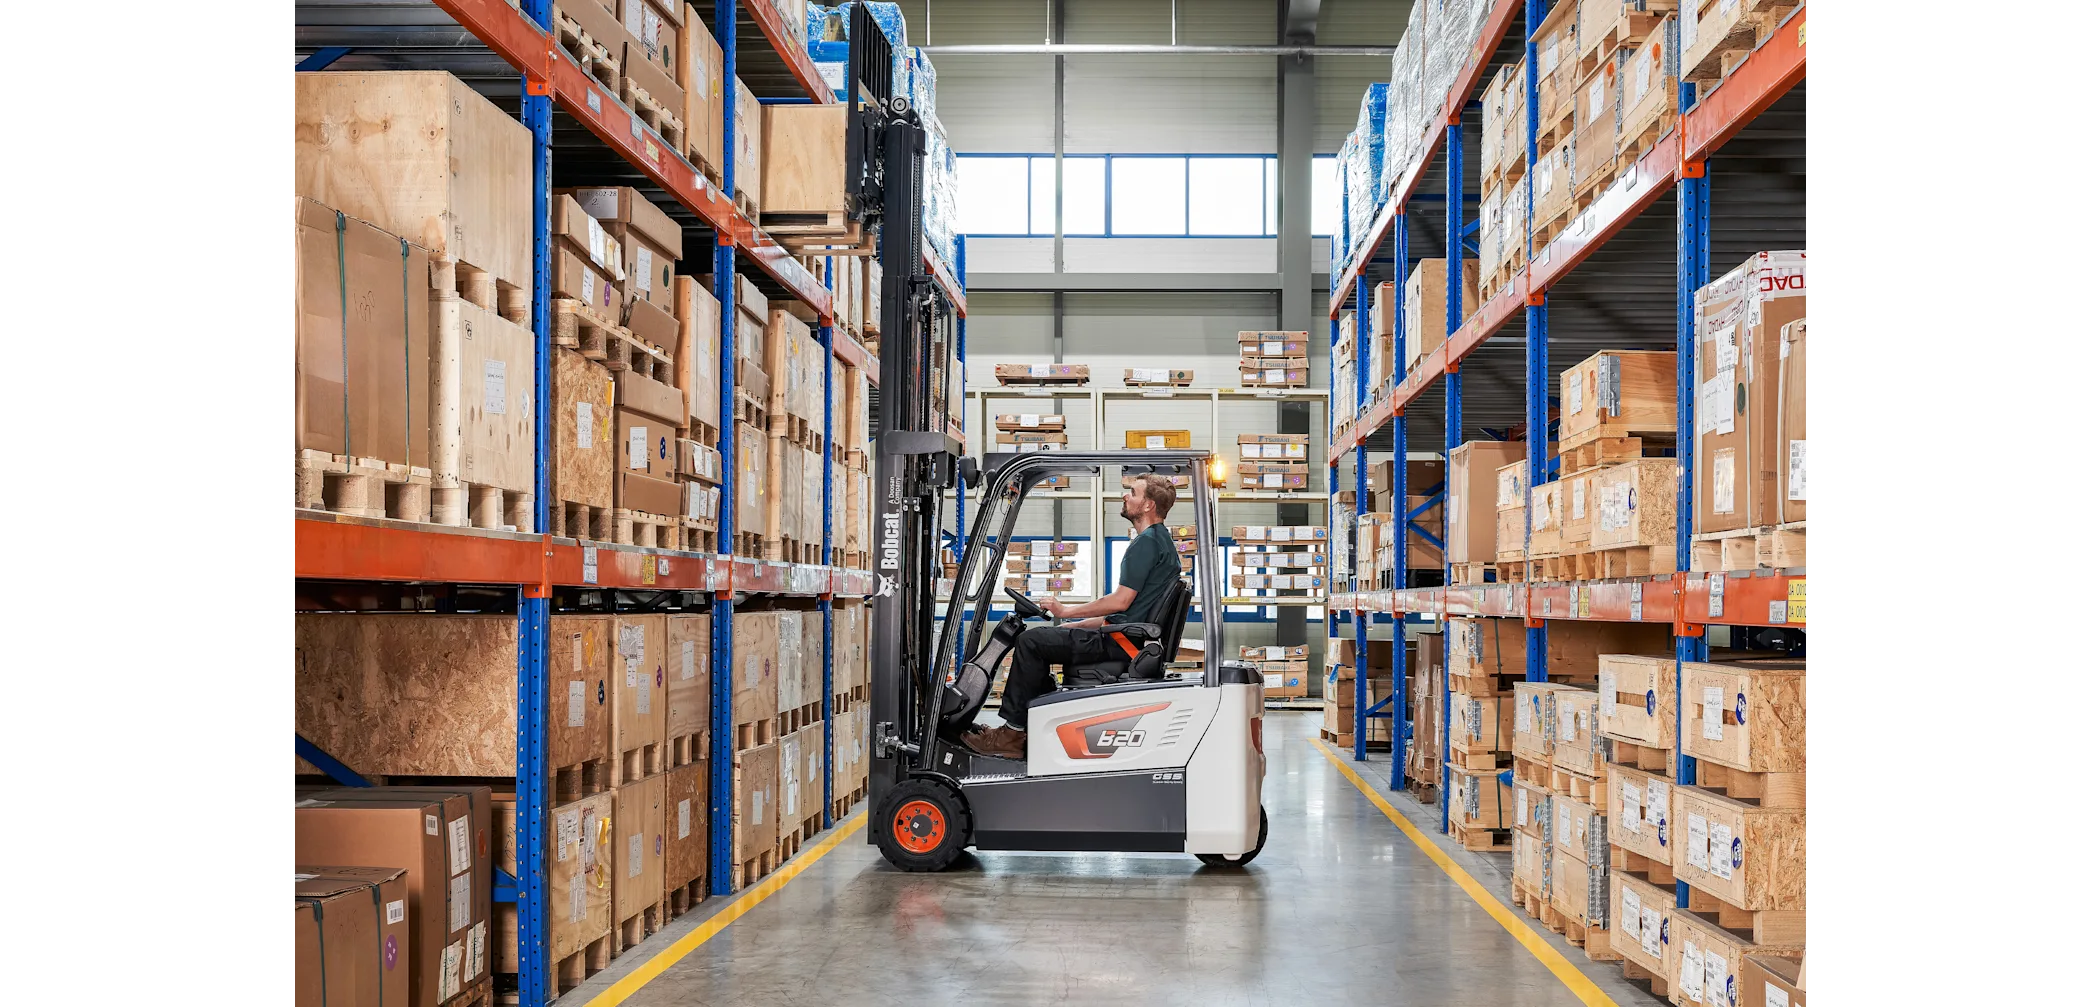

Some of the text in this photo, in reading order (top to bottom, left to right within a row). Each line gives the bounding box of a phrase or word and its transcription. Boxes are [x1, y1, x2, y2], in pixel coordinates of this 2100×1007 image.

[1759, 274, 1806, 291] DAC
[880, 512, 900, 570] Bobcat
[1096, 730, 1146, 748] B20
